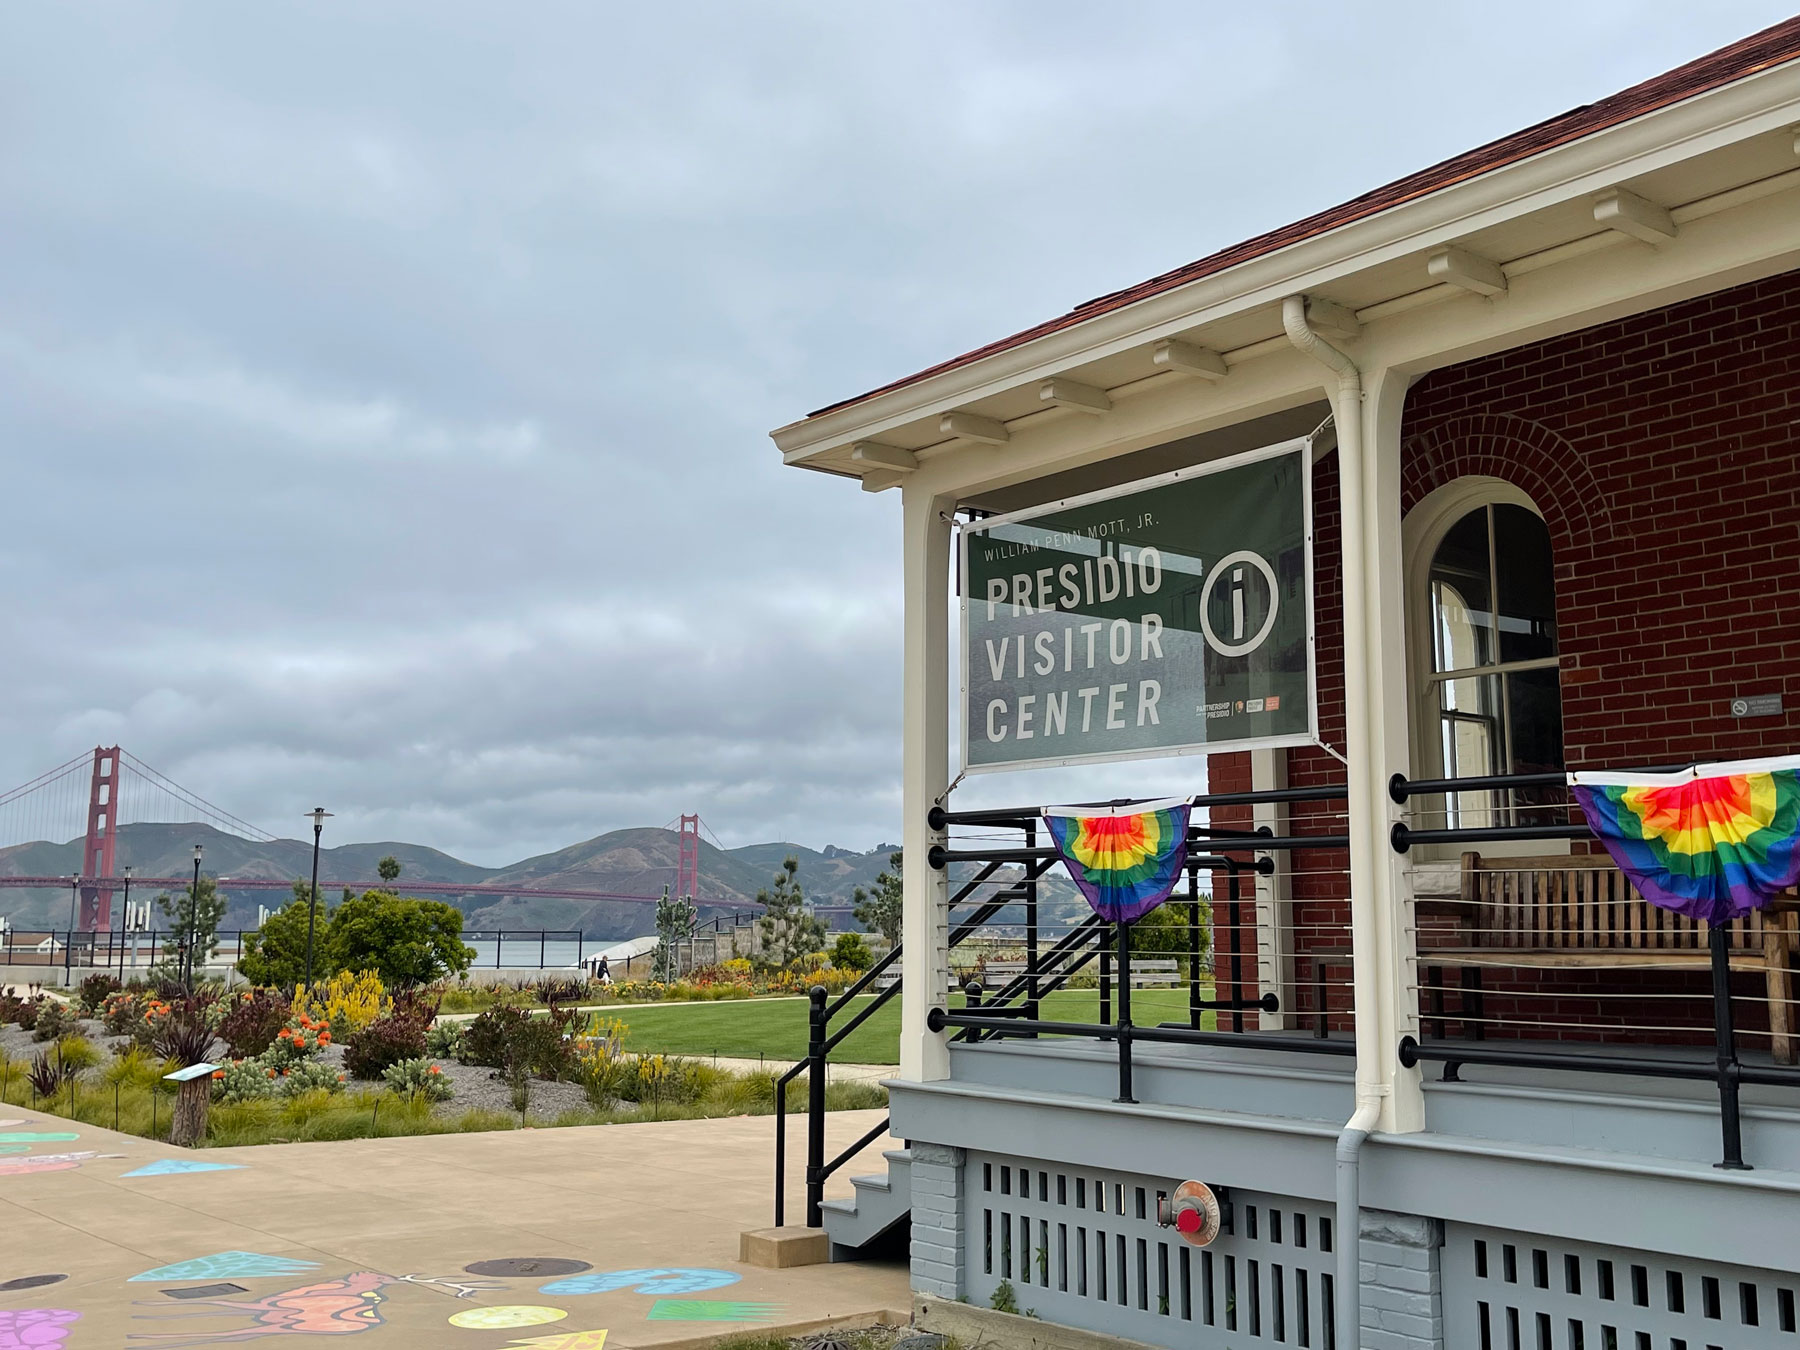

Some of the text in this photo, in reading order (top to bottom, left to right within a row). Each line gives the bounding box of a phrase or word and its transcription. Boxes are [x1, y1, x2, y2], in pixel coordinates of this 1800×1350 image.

[984, 512, 1160, 562] WILLIAM PENN MOTT, JR.
[987, 546, 1162, 621] PRESIDIO
[986, 613, 1164, 681] VISITOR
[986, 680, 1162, 742] CENTER
[1196, 702, 1230, 712] PARTNERSHIP
[1206, 709, 1230, 719] PRESIDIO
